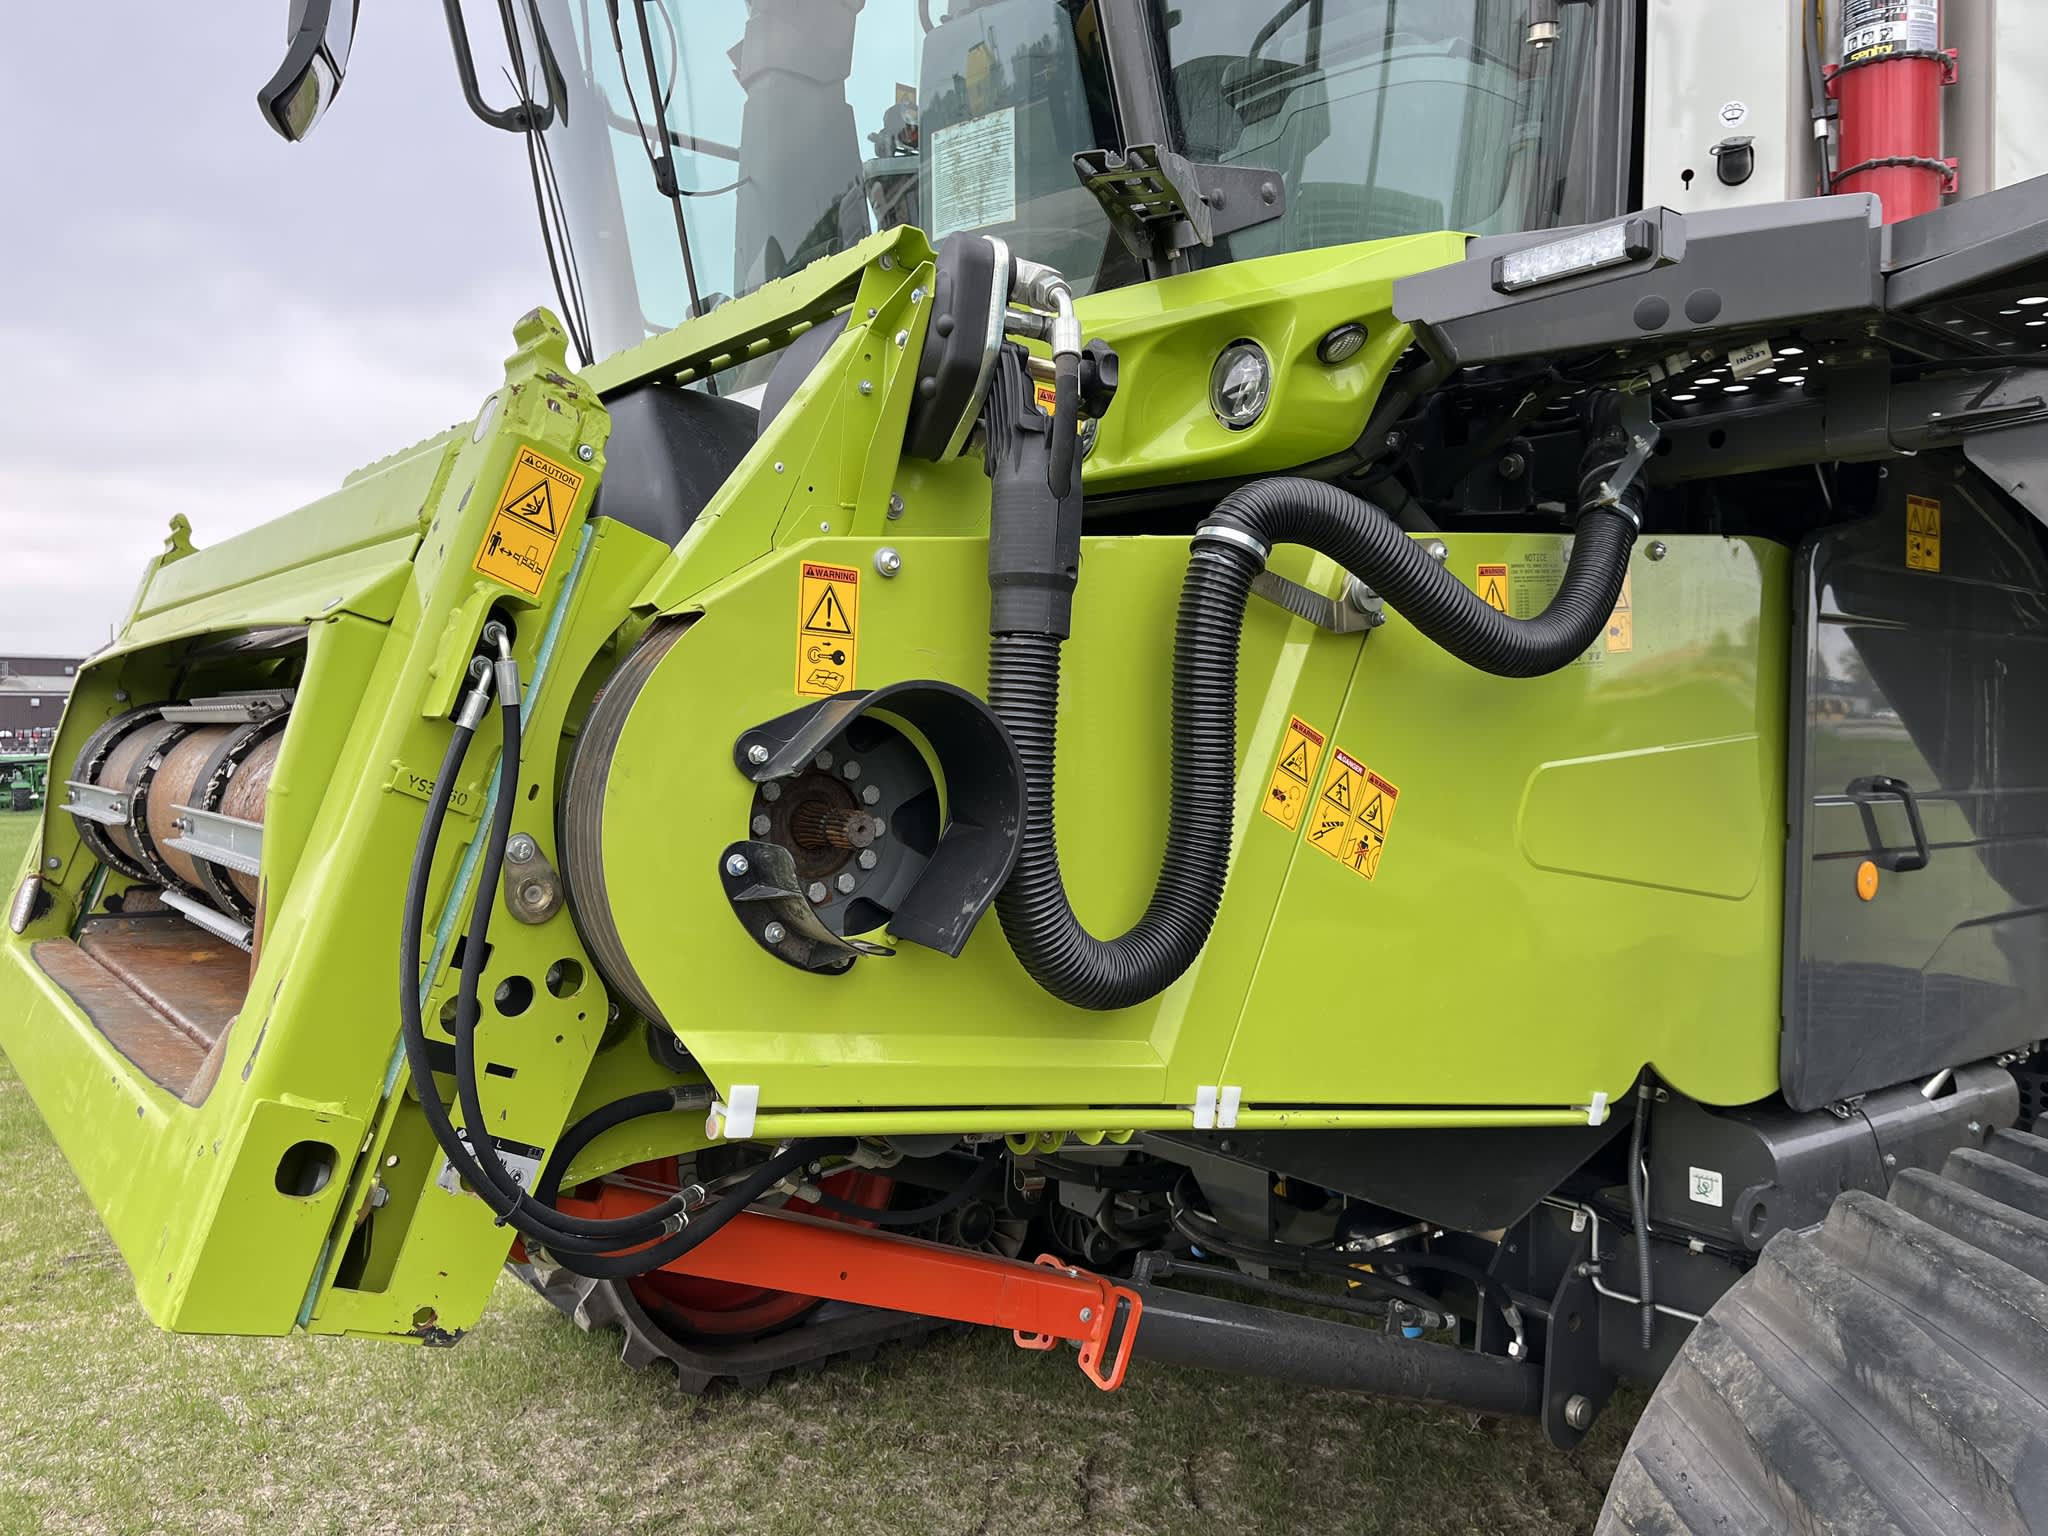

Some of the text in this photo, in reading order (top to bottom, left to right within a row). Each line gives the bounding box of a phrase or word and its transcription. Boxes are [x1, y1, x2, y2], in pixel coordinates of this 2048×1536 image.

[1736, 350, 1766, 364] LEONI
[535, 460, 577, 486] CAUTION
[815, 569, 855, 581] WARNING
